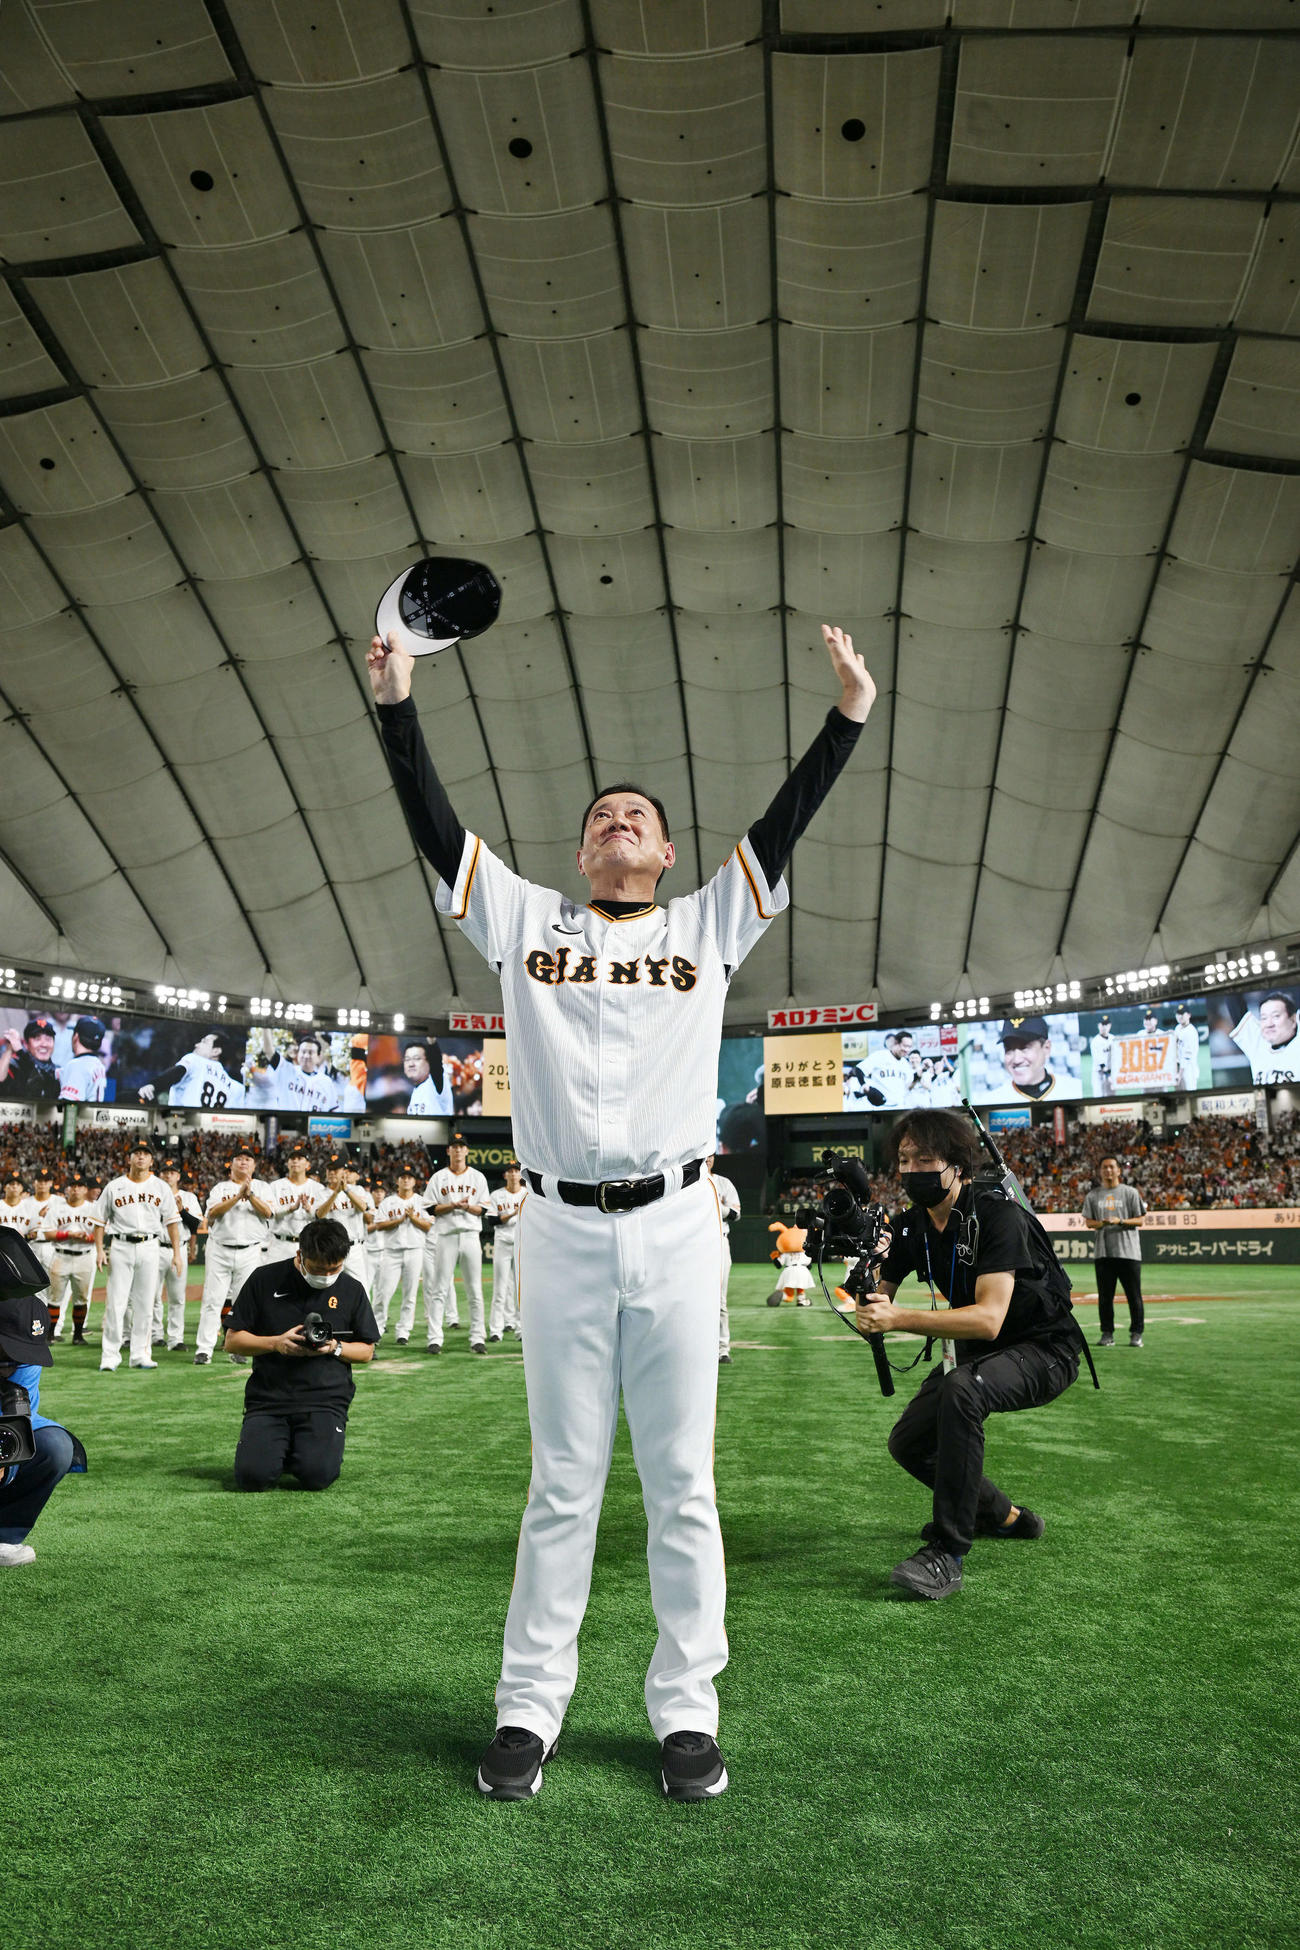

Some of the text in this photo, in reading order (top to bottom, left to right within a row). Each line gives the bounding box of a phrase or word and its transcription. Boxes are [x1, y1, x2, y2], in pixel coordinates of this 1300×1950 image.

[524, 947, 698, 992] GIANTS
[771, 1004, 875, 1027] オロナミンC
[1119, 1036, 1170, 1074] 1067
[771, 1060, 836, 1073] ありがとう
[771, 1075, 837, 1089] 原辰徳監督
[201, 1081, 227, 1108] 88
[441, 1184, 477, 1197] GIANTS
[114, 1192, 162, 1208] GIANTS
[1183, 1214, 1198, 1226] 83
[1274, 1212, 1300, 1224] あり
[1156, 1240, 1275, 1256] アサヒスーパードライ
